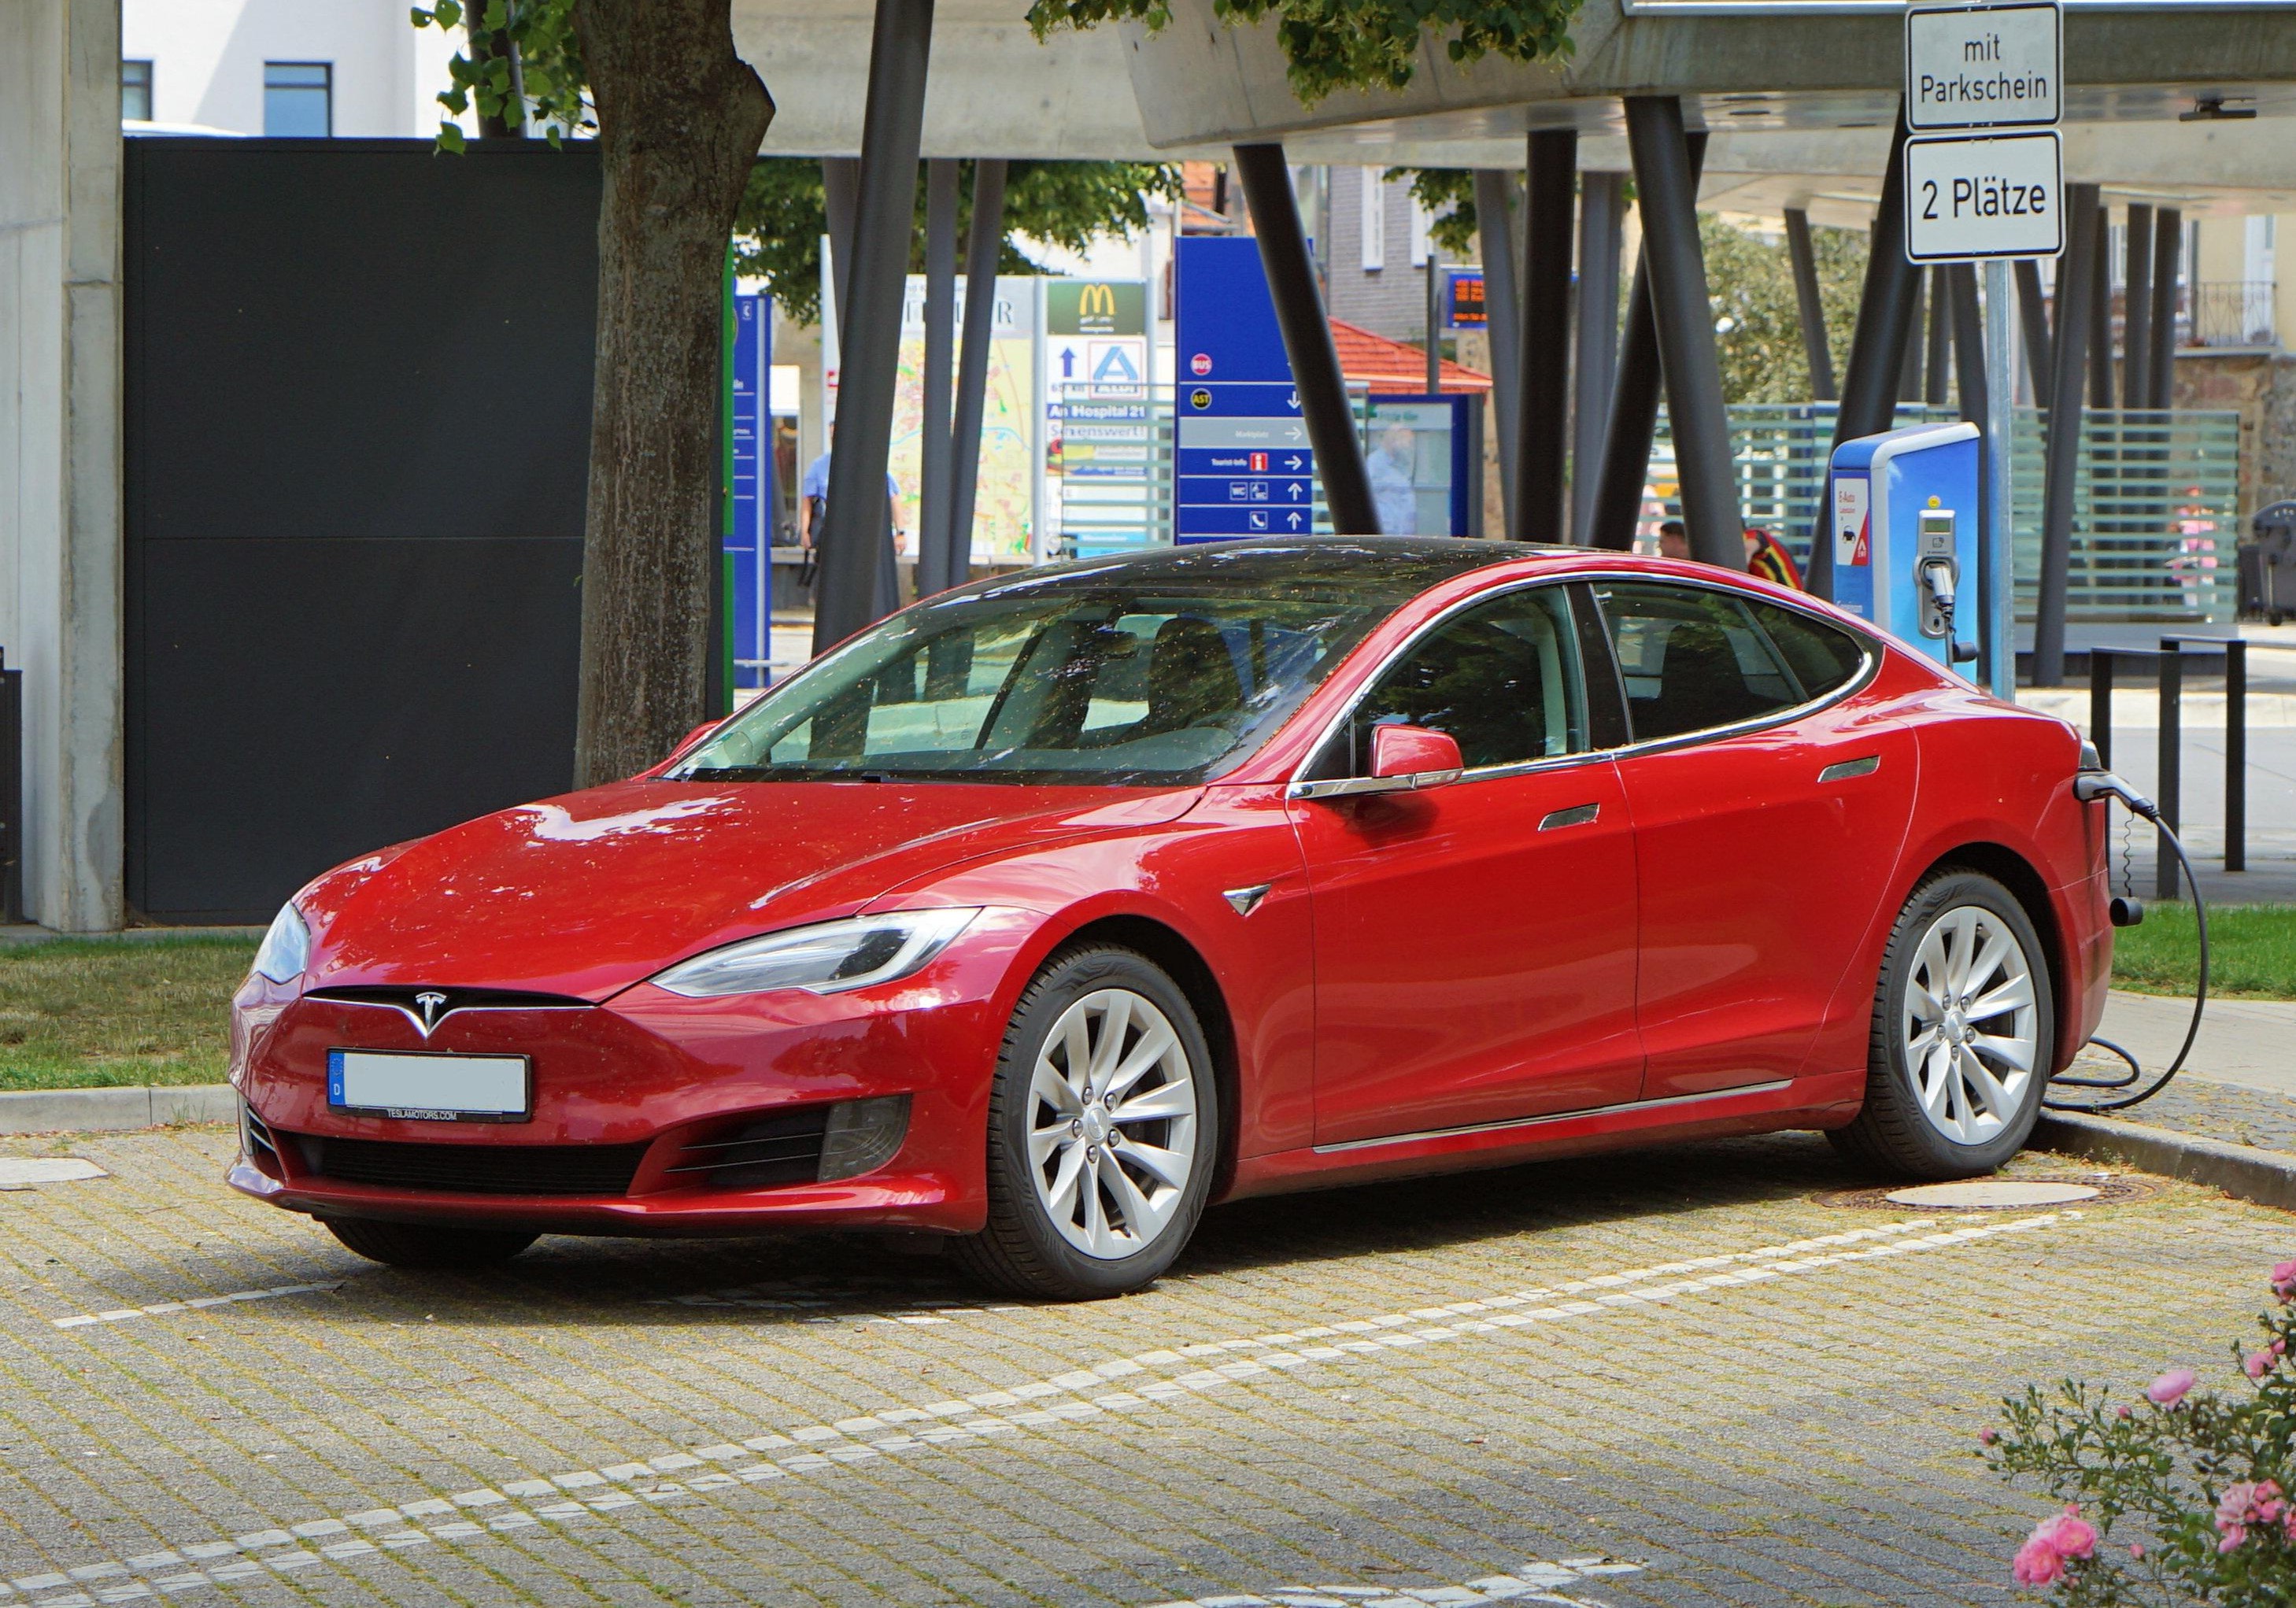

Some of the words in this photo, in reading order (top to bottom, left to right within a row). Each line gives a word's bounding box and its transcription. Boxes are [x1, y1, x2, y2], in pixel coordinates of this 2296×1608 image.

[1965, 32, 2000, 62] mit
[1921, 70, 2047, 103] Parkschein
[1922, 179, 1939, 220] 2
[1953, 176, 2046, 219] Plätze
[1193, 360, 1211, 370] BUS
[1192, 394, 1210, 405] AST
[1071, 405, 1128, 420] Hospital
[1232, 486, 1246, 496] WC
[334, 1084, 340, 1095] D
[386, 1108, 457, 1121] TESLAMOTORS.COM
